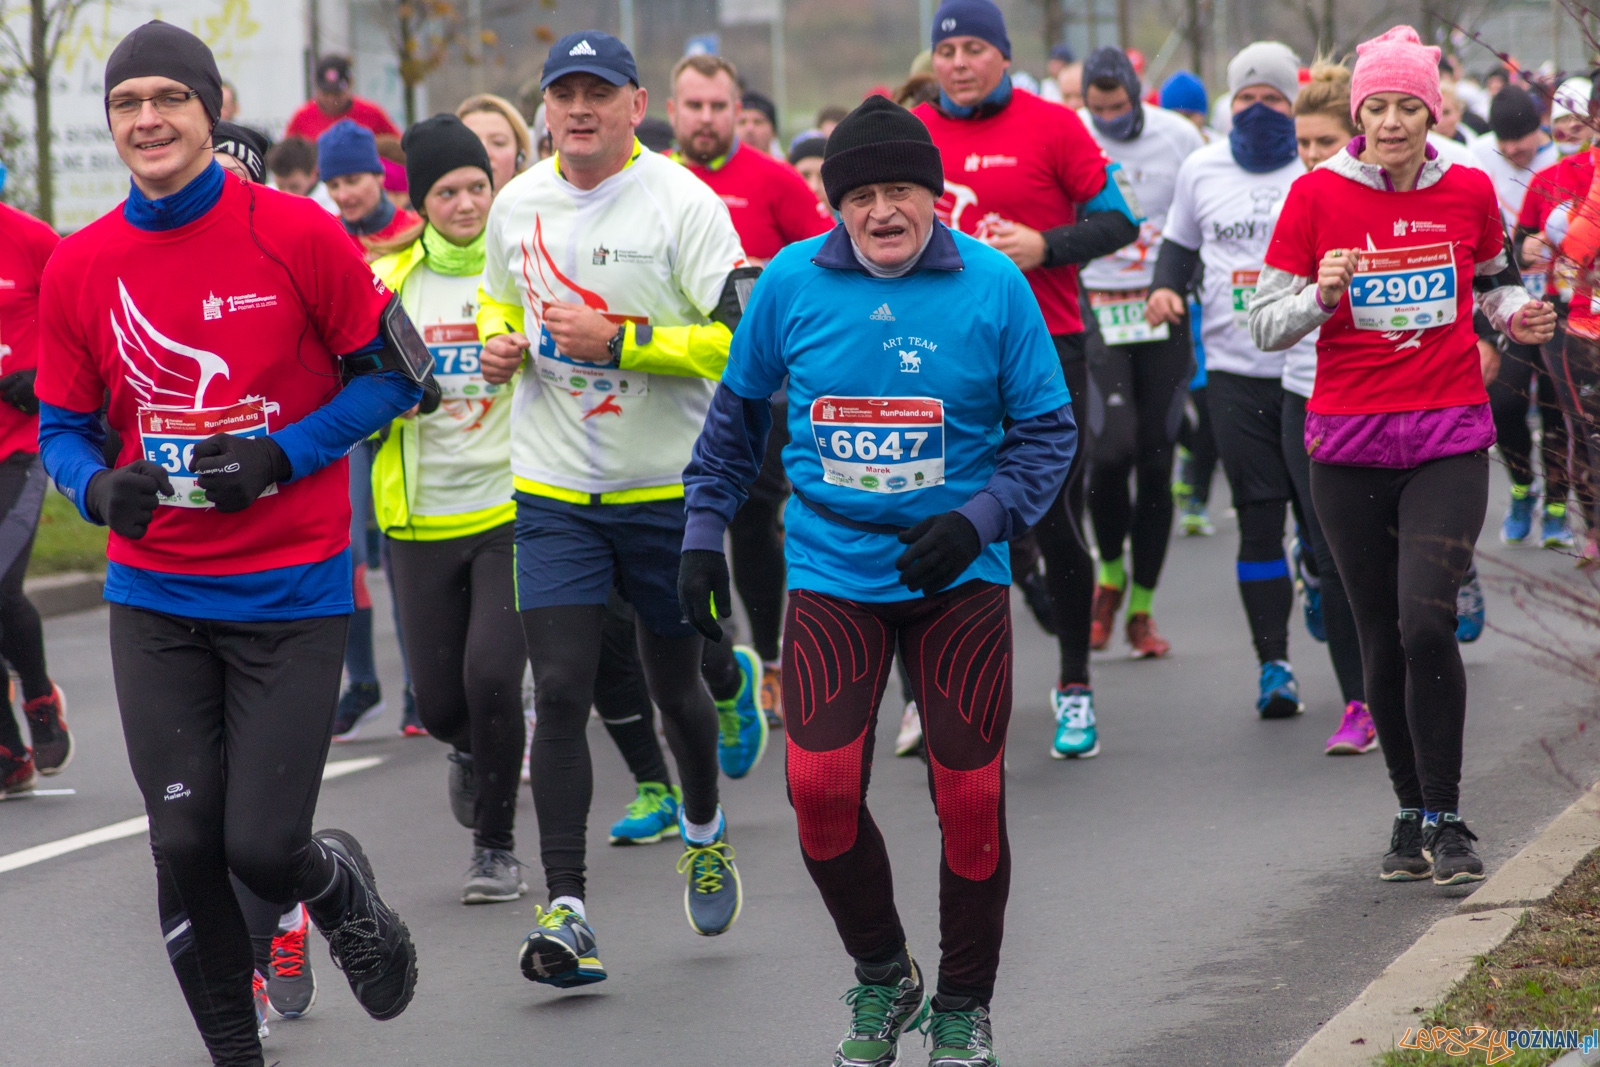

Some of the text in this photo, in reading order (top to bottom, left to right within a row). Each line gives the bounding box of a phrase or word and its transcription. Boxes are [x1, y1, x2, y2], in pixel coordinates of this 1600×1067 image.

[1364, 272, 1447, 304] 2902
[226, 296, 237, 312] 1
[1099, 304, 1147, 325] 810
[883, 336, 938, 353] ART TEAM
[438, 347, 482, 373] 75
[204, 412, 259, 429] RunPoland.org
[880, 409, 934, 419] RunPoland.org
[818, 430, 929, 461] E 6647
[148, 451, 157, 462] E
[866, 466, 891, 474] Marek
